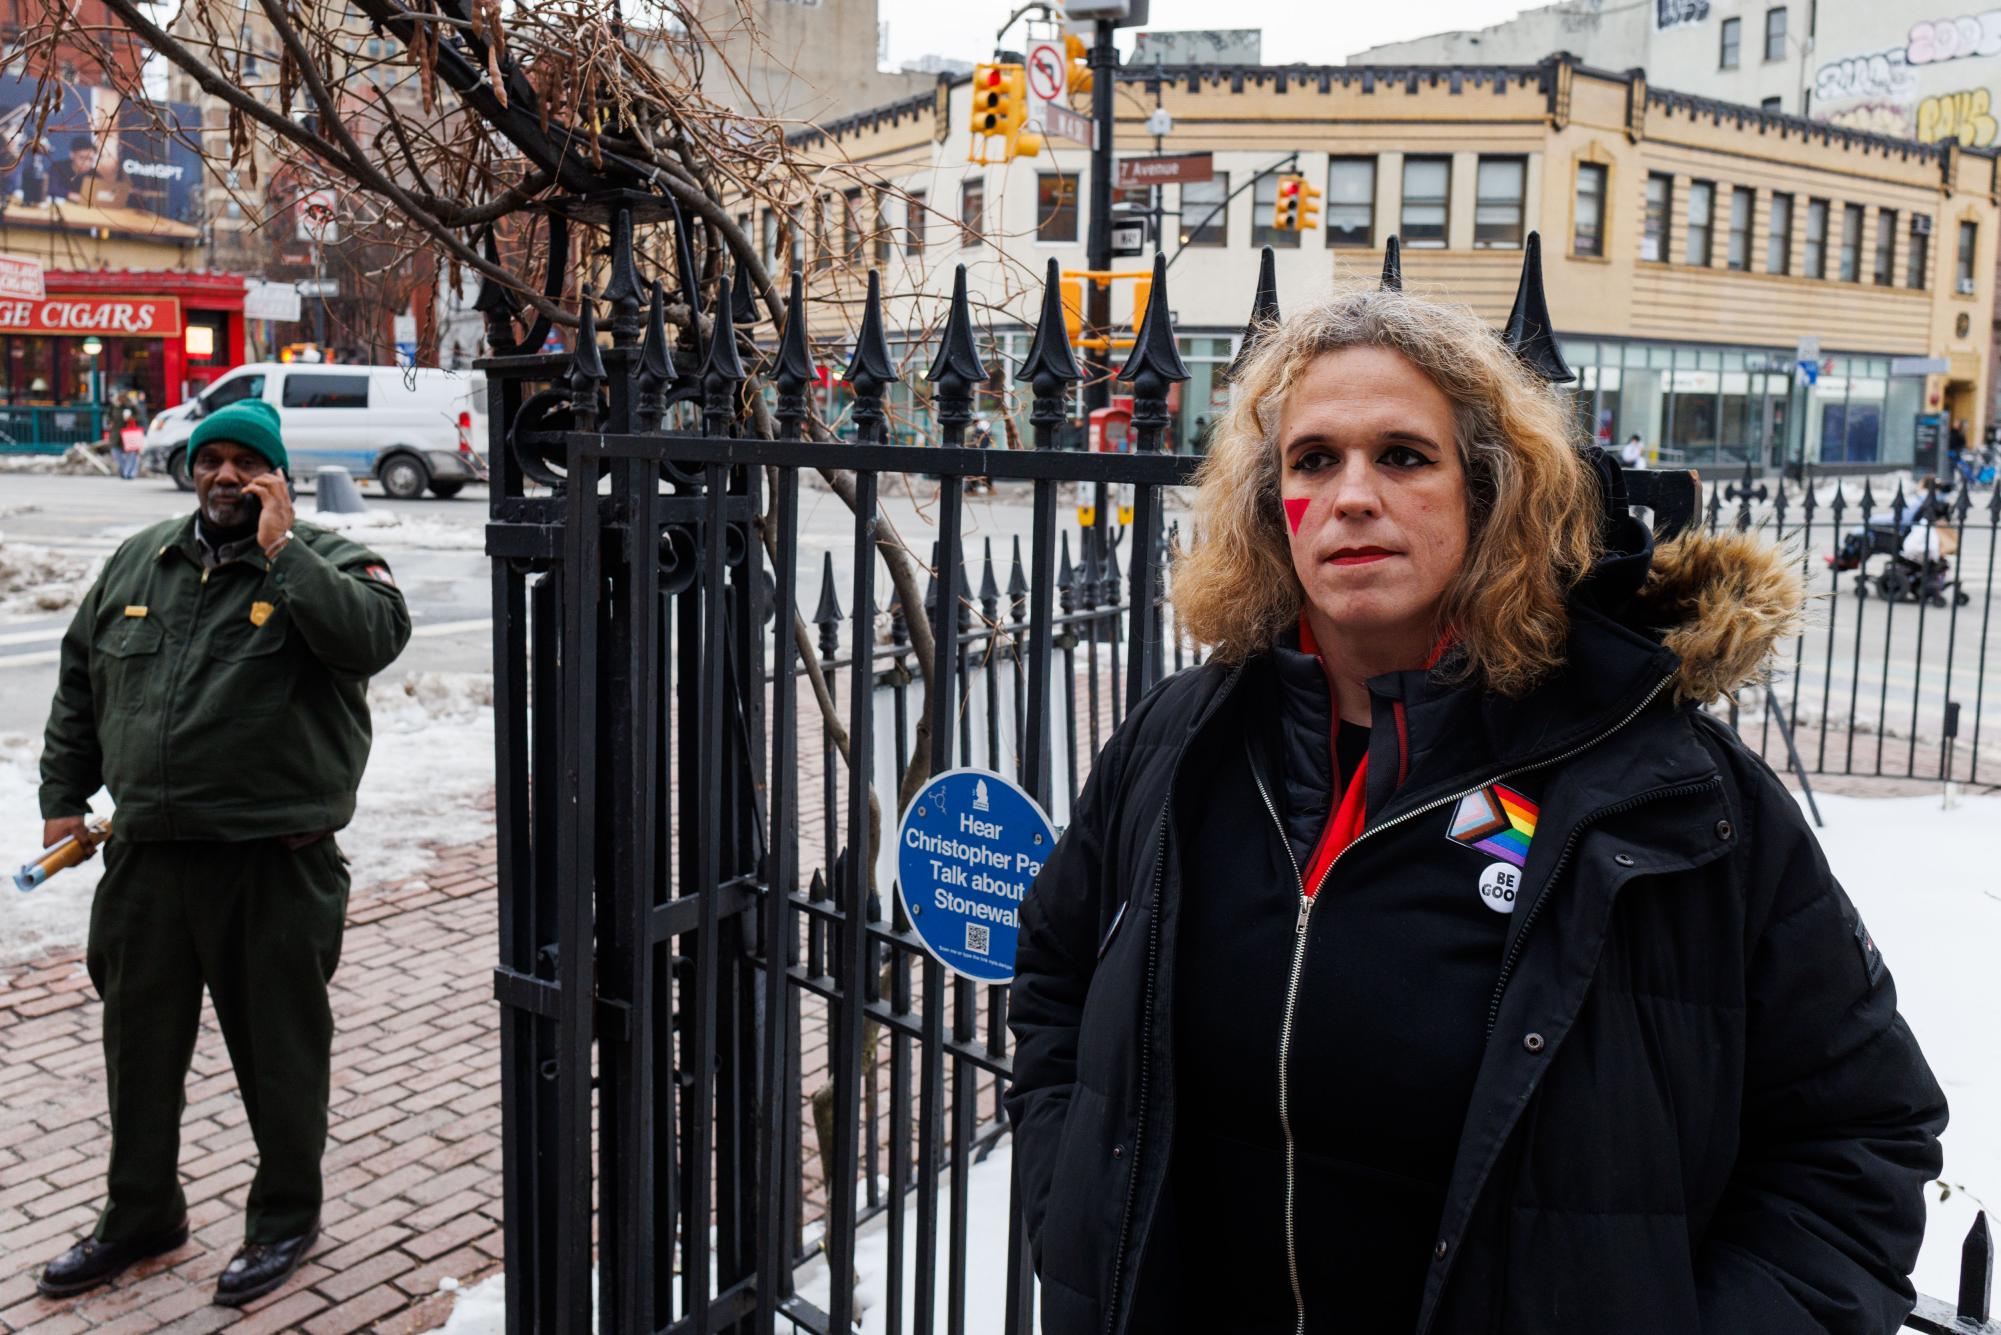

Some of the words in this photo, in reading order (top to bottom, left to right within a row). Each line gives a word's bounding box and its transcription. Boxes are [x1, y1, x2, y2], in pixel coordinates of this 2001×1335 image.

[123, 159, 184, 181] ChatGPT
[1120, 162, 1129, 177] 7
[1133, 162, 1179, 176] Avenue
[40, 302, 155, 333] CIGARS
[960, 812, 1003, 840] Hear
[906, 827, 1012, 870] Christopher
[1016, 852, 1044, 877] Pa
[930, 859, 968, 888] Talk
[971, 872, 1025, 901] about
[1481, 883, 1516, 902] GOO
[1496, 871, 1515, 888] BE
[934, 887, 1021, 929] Stonewal
